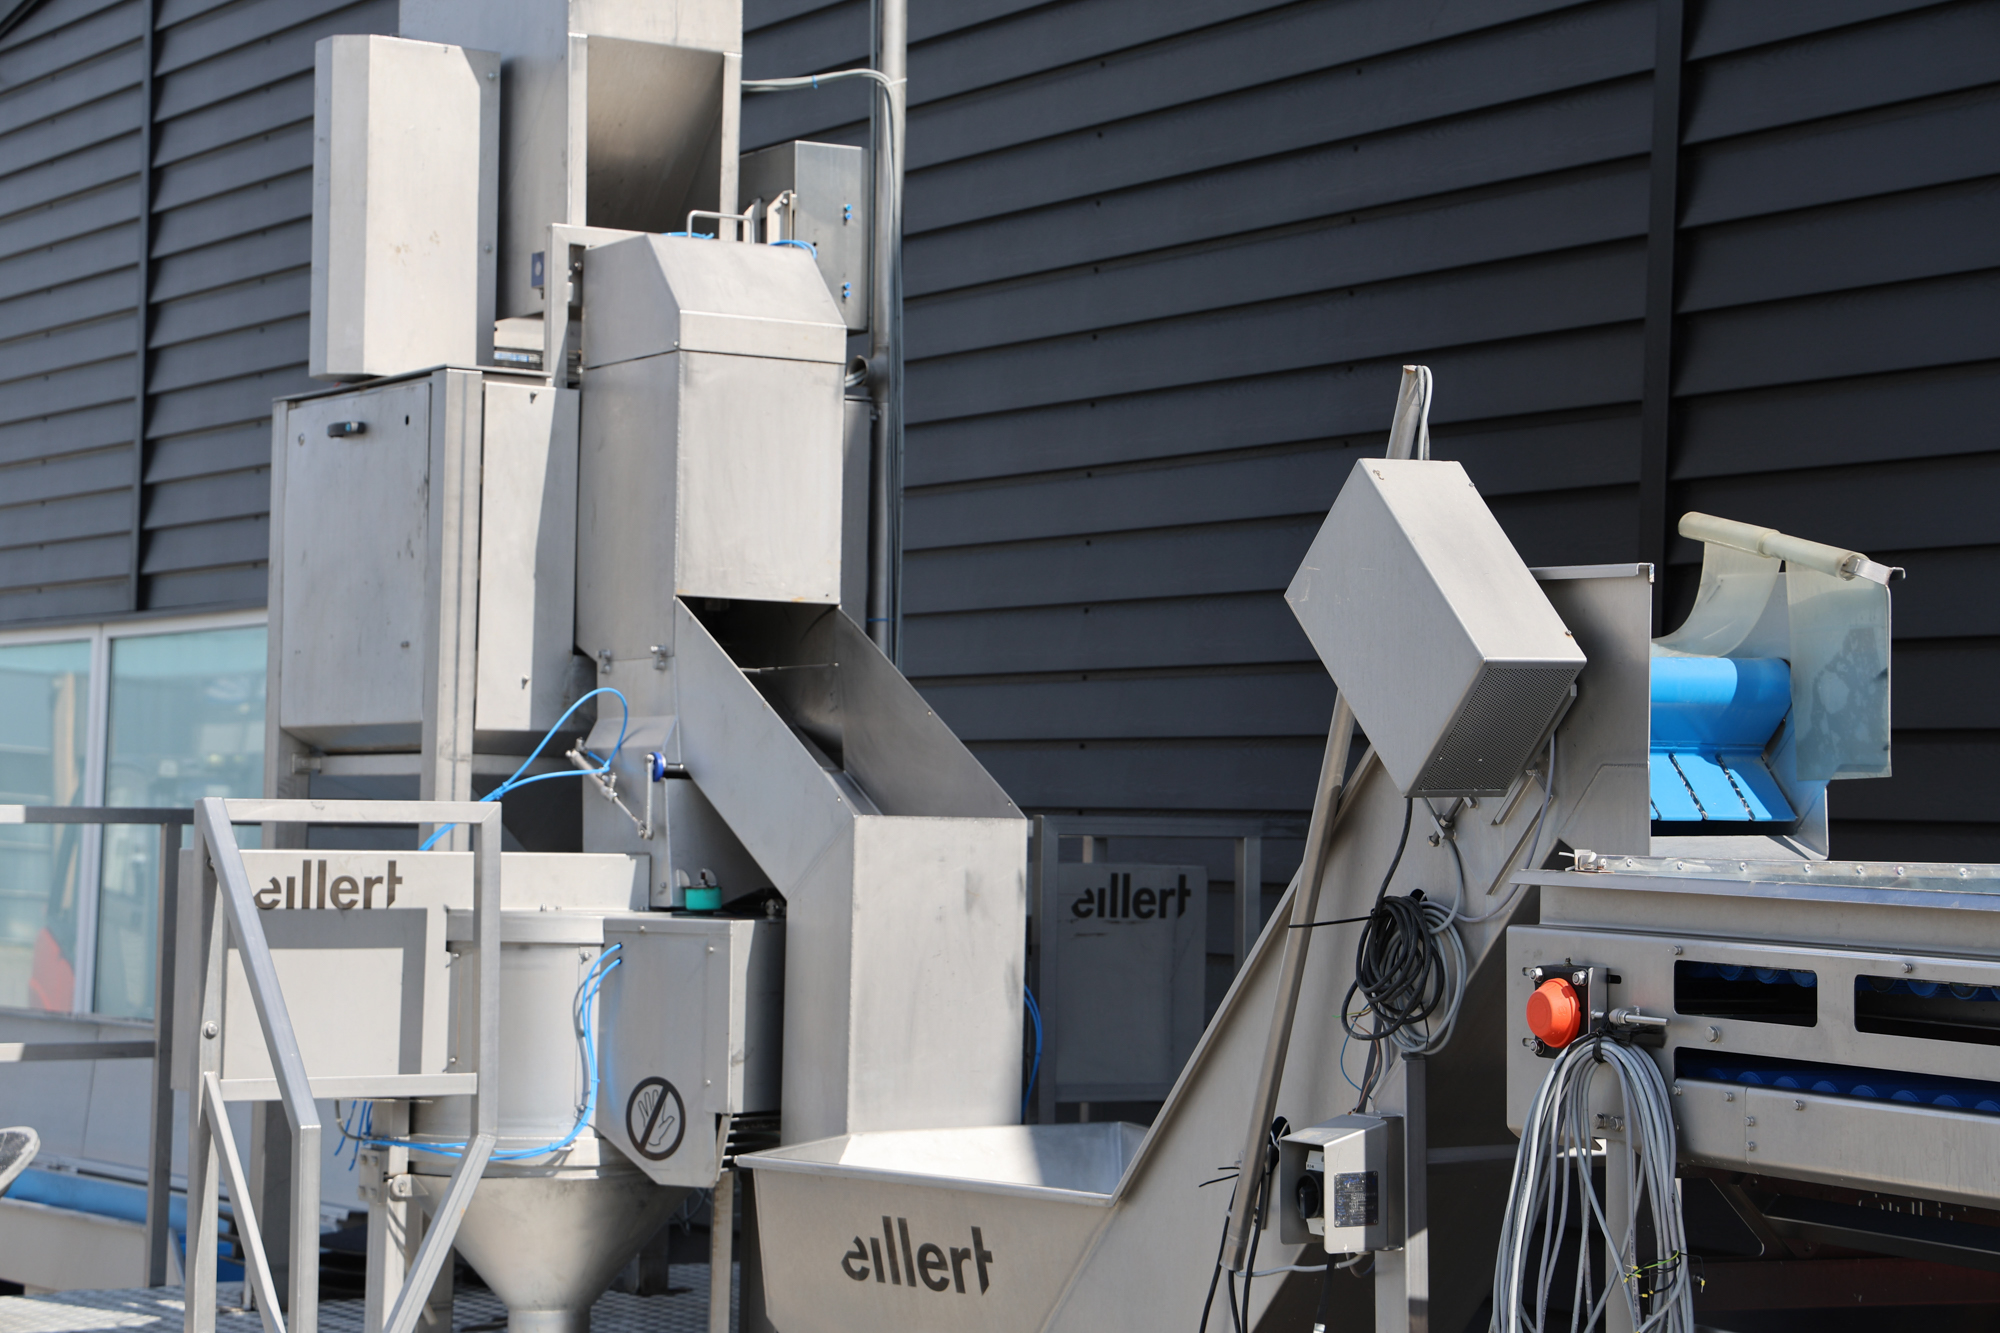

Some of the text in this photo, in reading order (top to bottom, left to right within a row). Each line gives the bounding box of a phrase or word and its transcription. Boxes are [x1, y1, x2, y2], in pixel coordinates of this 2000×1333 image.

[253, 859, 403, 910] eillert
[1071, 872, 1191, 919] eillert
[841, 1215, 993, 1296] eillert
